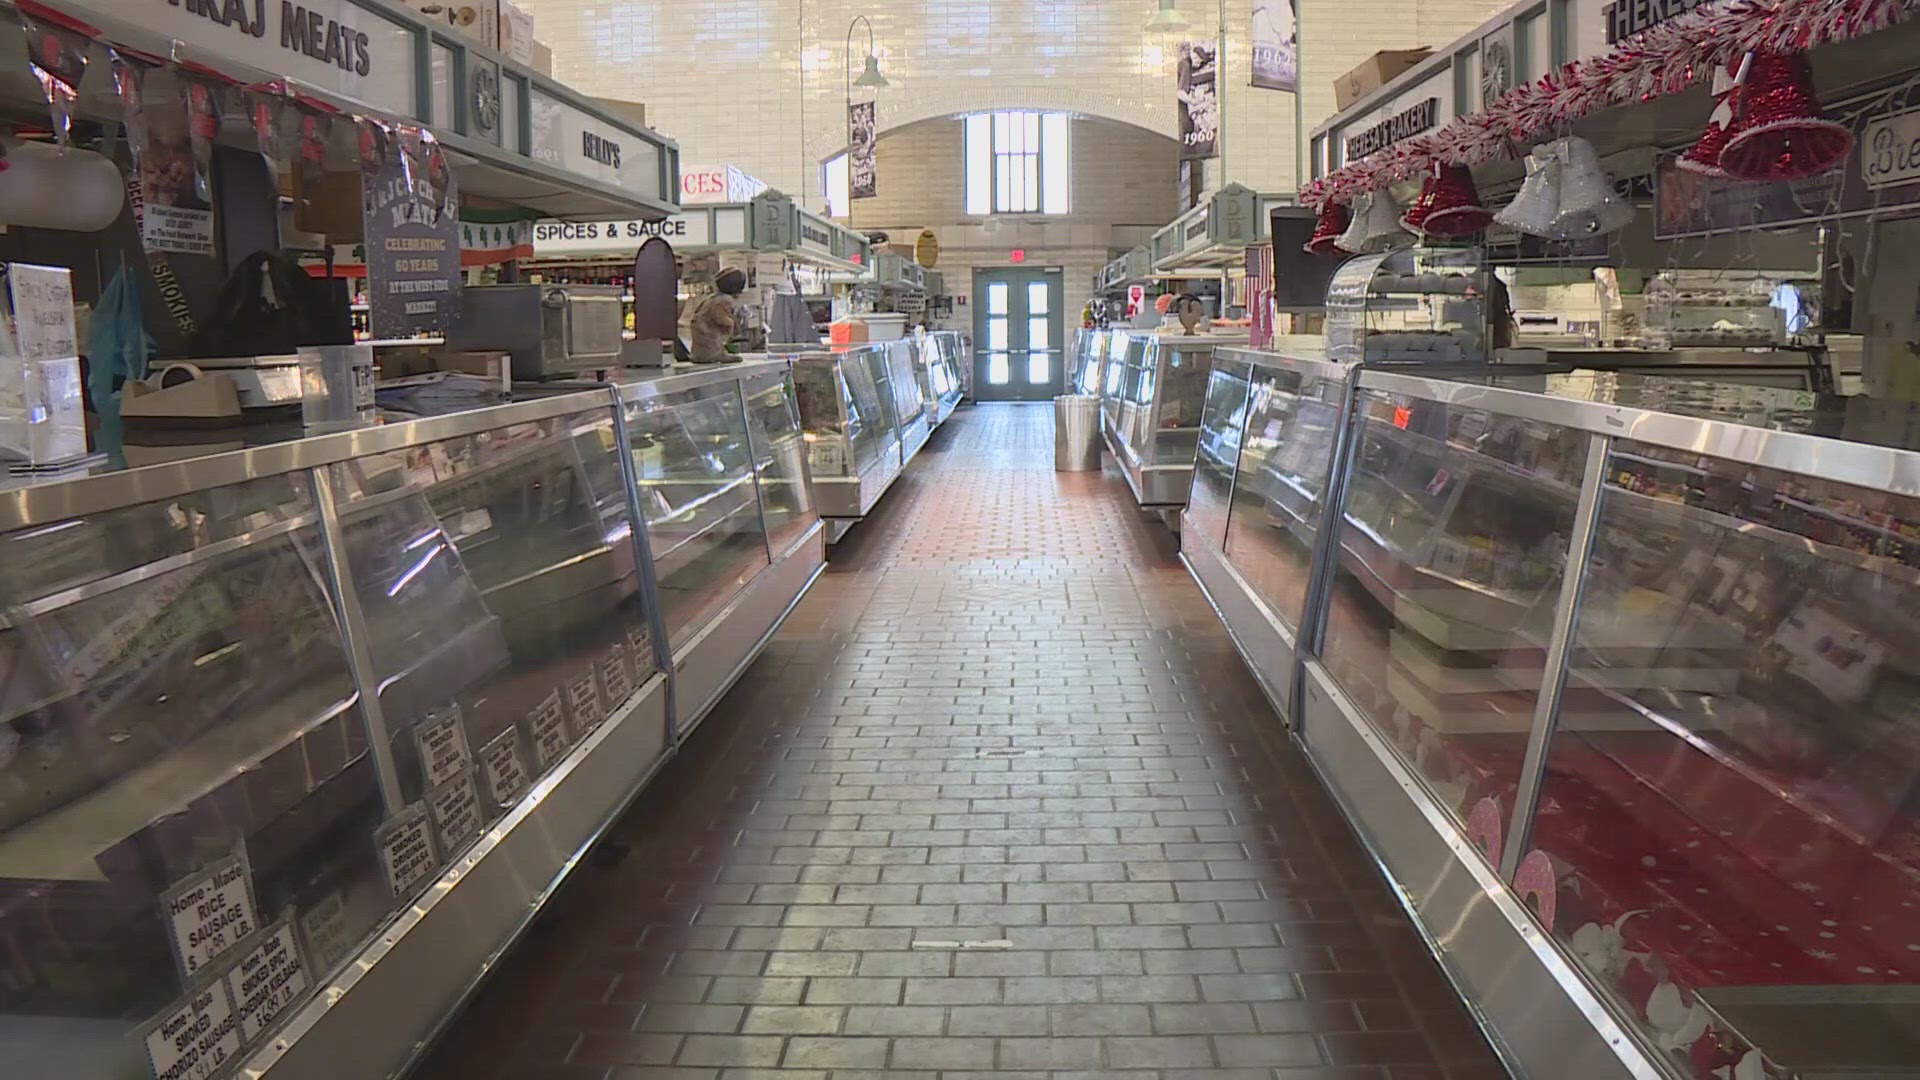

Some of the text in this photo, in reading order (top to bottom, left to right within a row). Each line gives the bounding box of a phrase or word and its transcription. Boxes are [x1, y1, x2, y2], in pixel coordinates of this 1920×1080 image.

[281, 1, 370, 77] MEATS
[1391, 98, 1434, 142] BAKERY
[1183, 128, 1214, 145] 1960
[766, 205, 779, 221] D
[385, 238, 446, 252] CELEBRATING
[536, 221, 686, 240] SPICES & SAUCE
[396, 259, 439, 272] 60 YEARS
[153, 264, 195, 333] SMOKIES
[392, 829, 421, 855] SMOKED
[393, 840, 426, 868] ORIGINAL
[395, 849, 429, 881] KIELBASA
[171, 888, 204, 915] Home
[213, 866, 242, 890] Made
[197, 893, 226, 921] RICE
[189, 903, 243, 948] SAUSAGE
[234, 921, 252, 939] LB.
[242, 947, 288, 997] SMOKED SPICY
[240, 958, 301, 1021] CHEDDAR KIELBASA
[161, 1014, 187, 1041] Home
[176, 1014, 211, 1052] SMOKED
[199, 1013, 236, 1055] SAUSAGE
